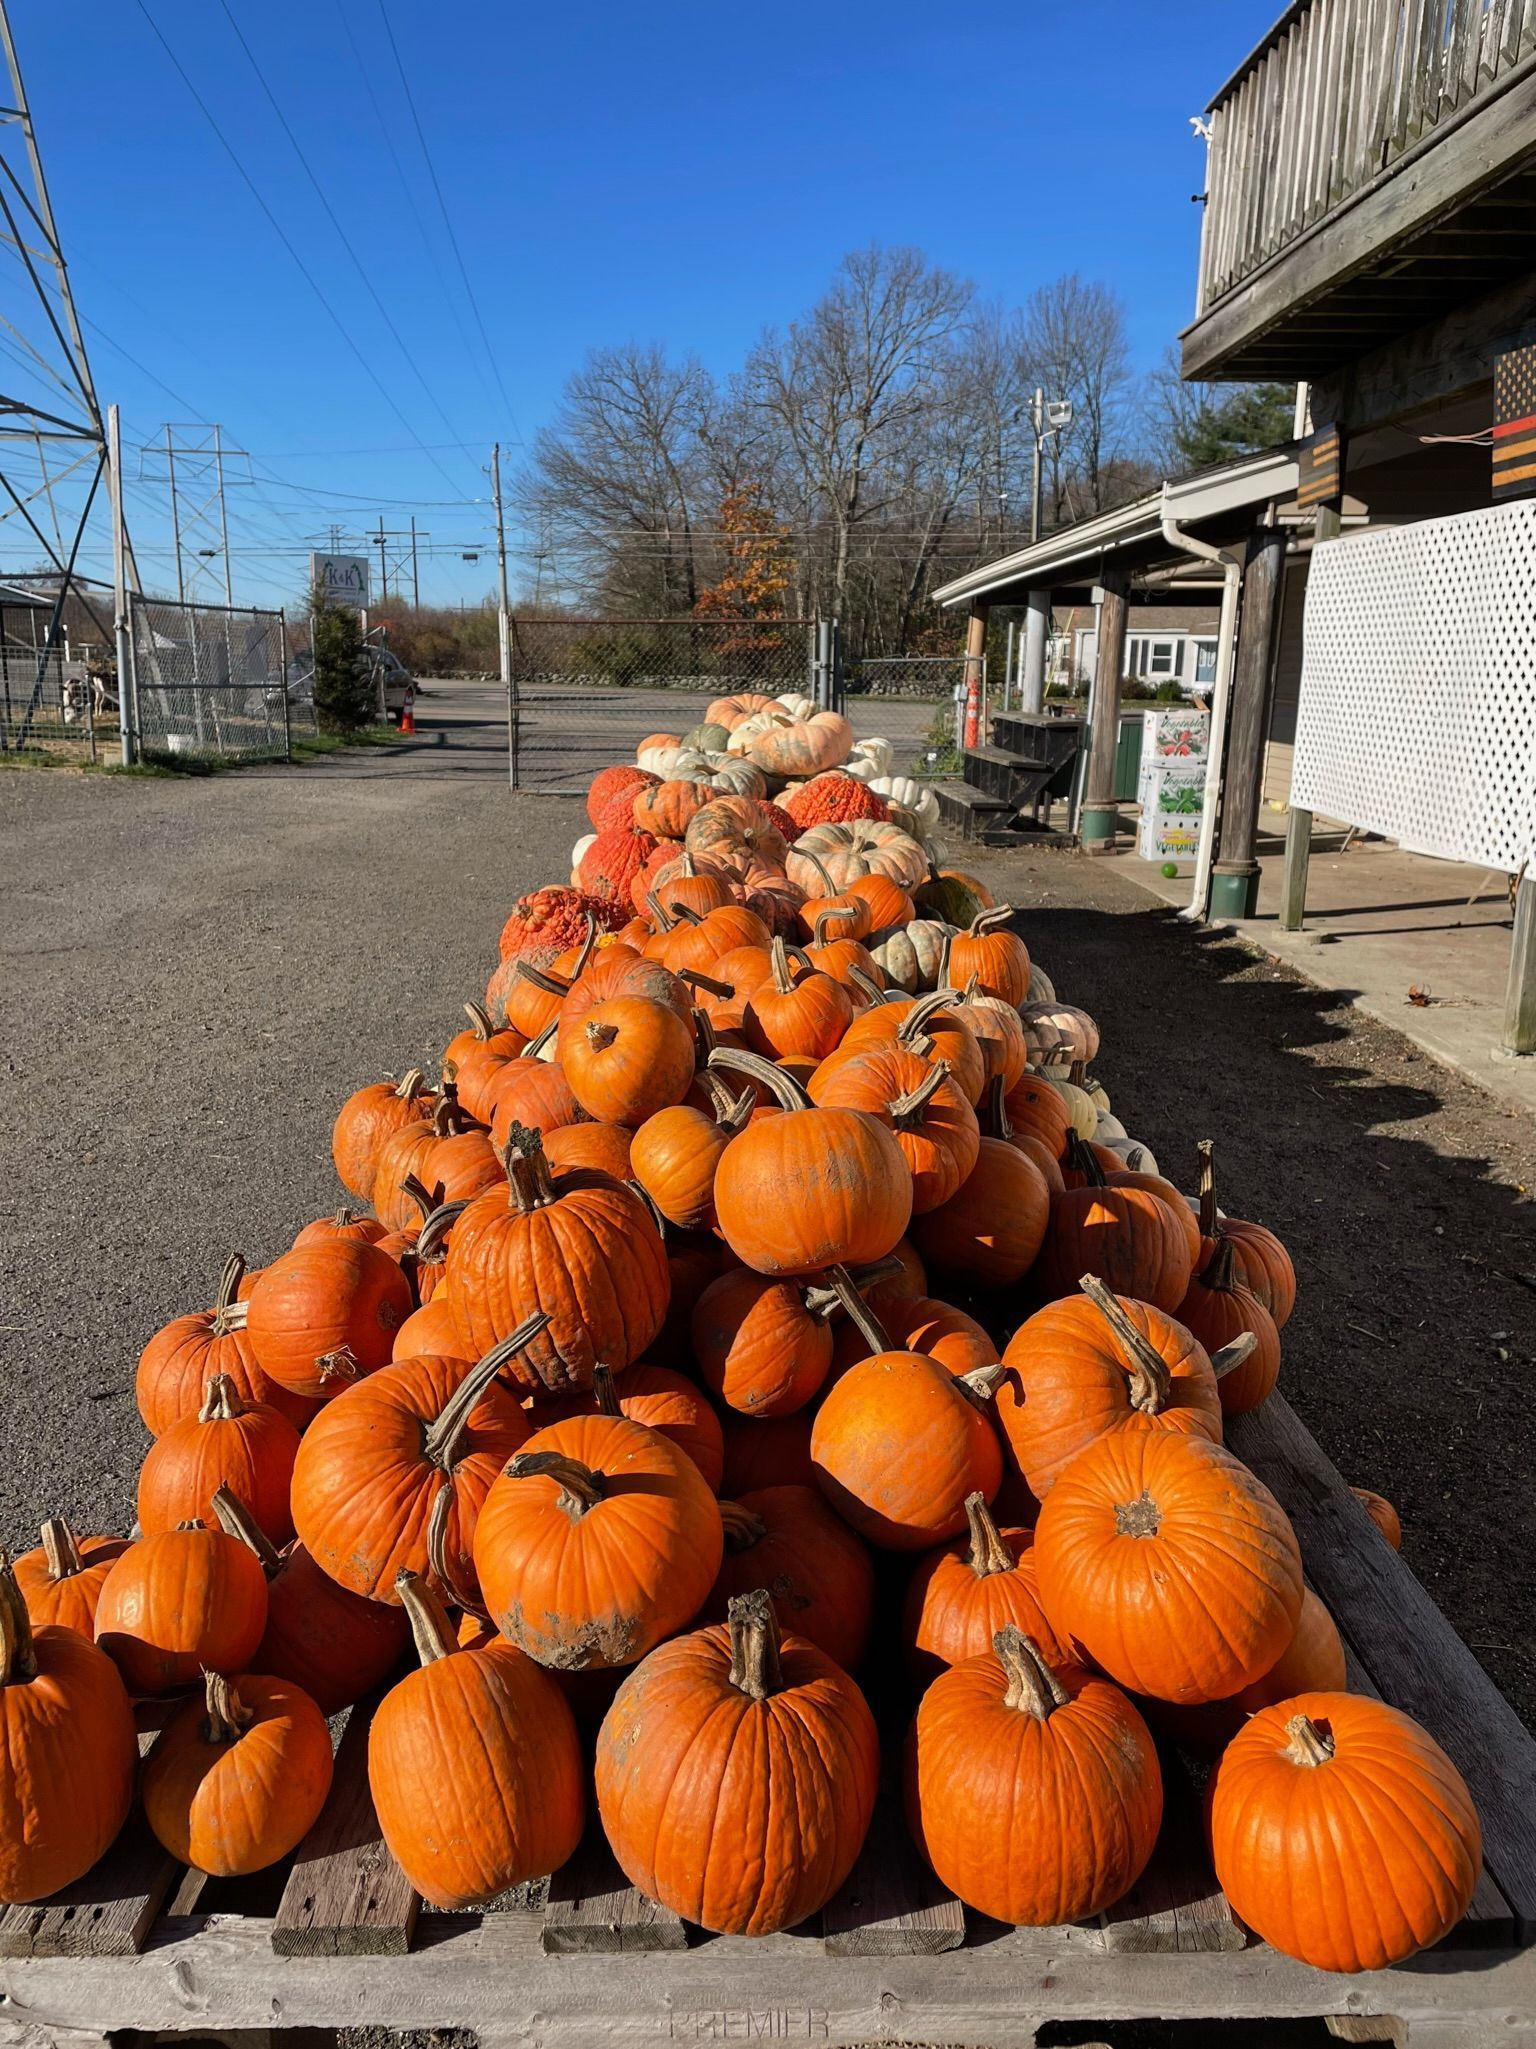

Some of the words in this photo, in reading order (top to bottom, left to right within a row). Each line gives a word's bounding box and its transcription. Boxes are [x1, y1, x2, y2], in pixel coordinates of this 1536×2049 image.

[329, 568, 338, 585] K
[345, 570, 355, 586] K
[1160, 717, 1205, 731] Vegetables
[670, 2007, 829, 2038] PREMIER
